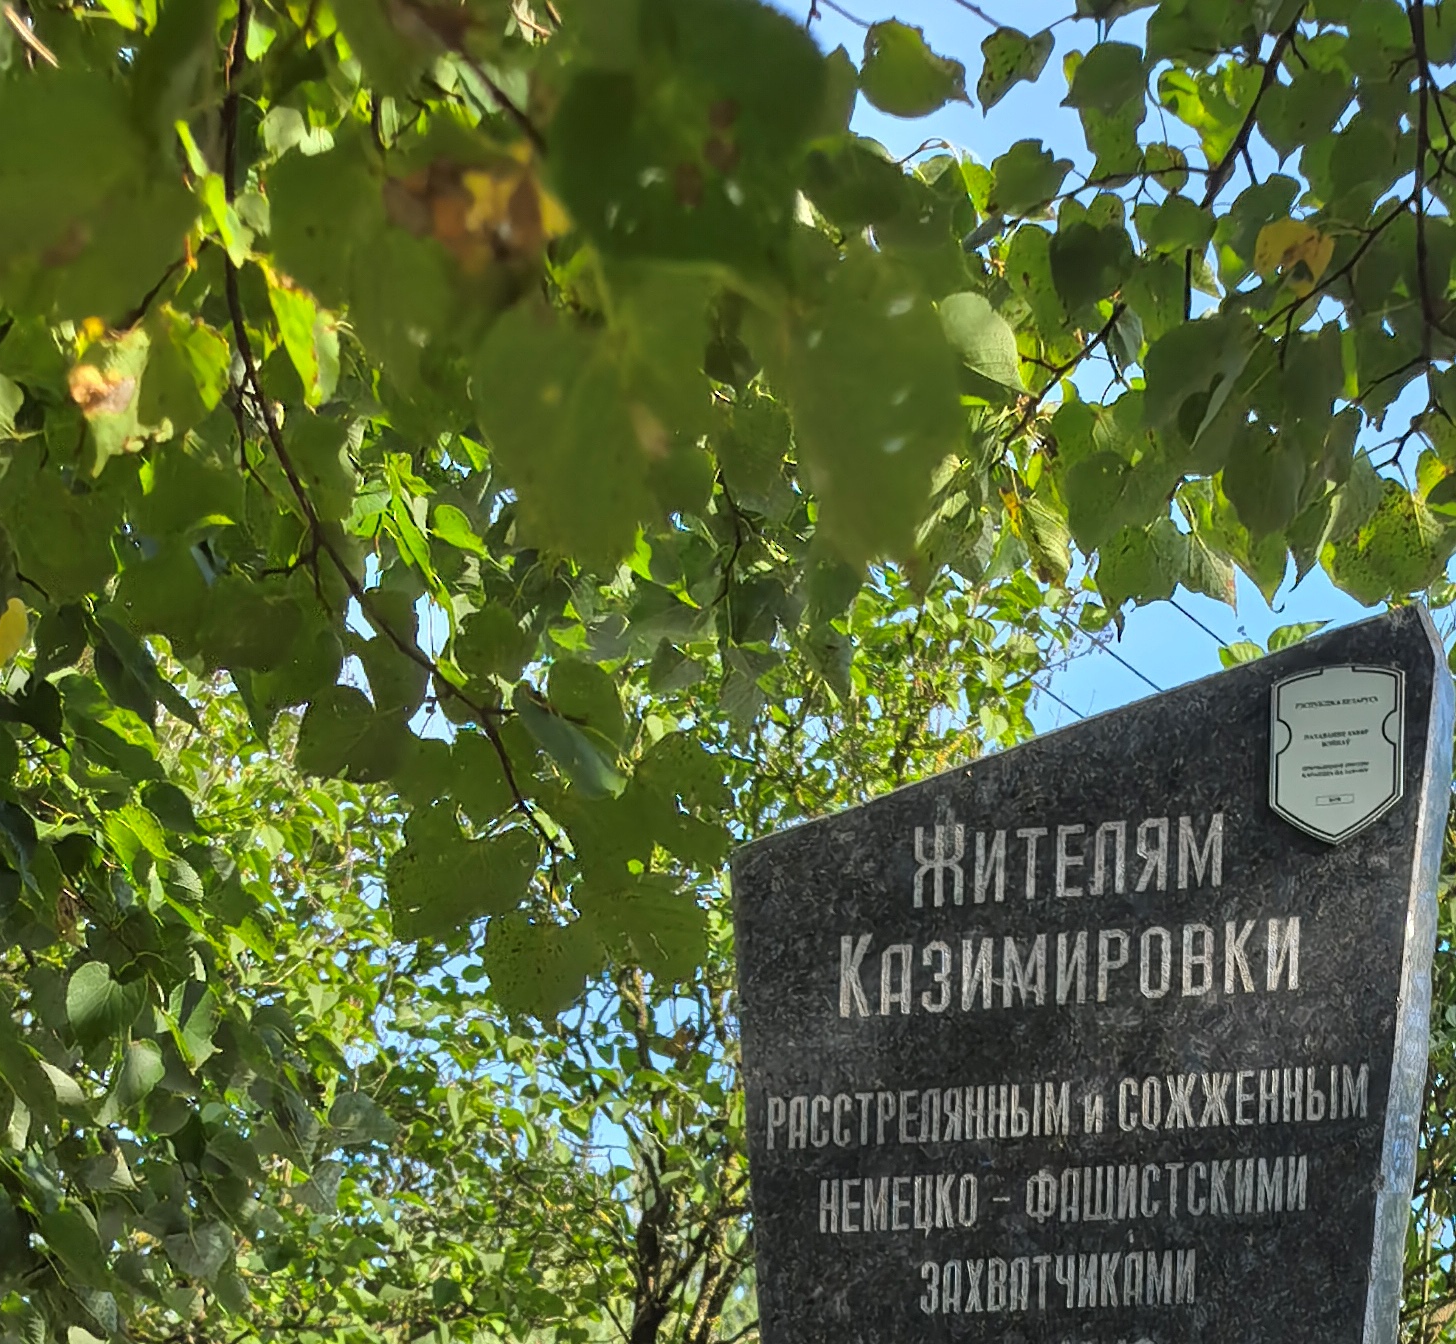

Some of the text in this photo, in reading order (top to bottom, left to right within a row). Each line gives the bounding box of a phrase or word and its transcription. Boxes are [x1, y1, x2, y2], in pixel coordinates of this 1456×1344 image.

[912, 813, 1225, 909] ЖИТЕЛЯМ
[837, 916, 1301, 1019] КАЗИМИРОВКИ
[766, 1081, 1071, 1150] РАССТРЕЛЯННЫМ
[1118, 1062, 1370, 1132] СОЖЖЕННЫМ
[819, 1173, 978, 1239] НЕМЕЦКО
[1025, 1154, 1308, 1224] ФАШИСТСКИМИ
[919, 1248, 1197, 1316] ЗАХВАТЧИКАМИ
